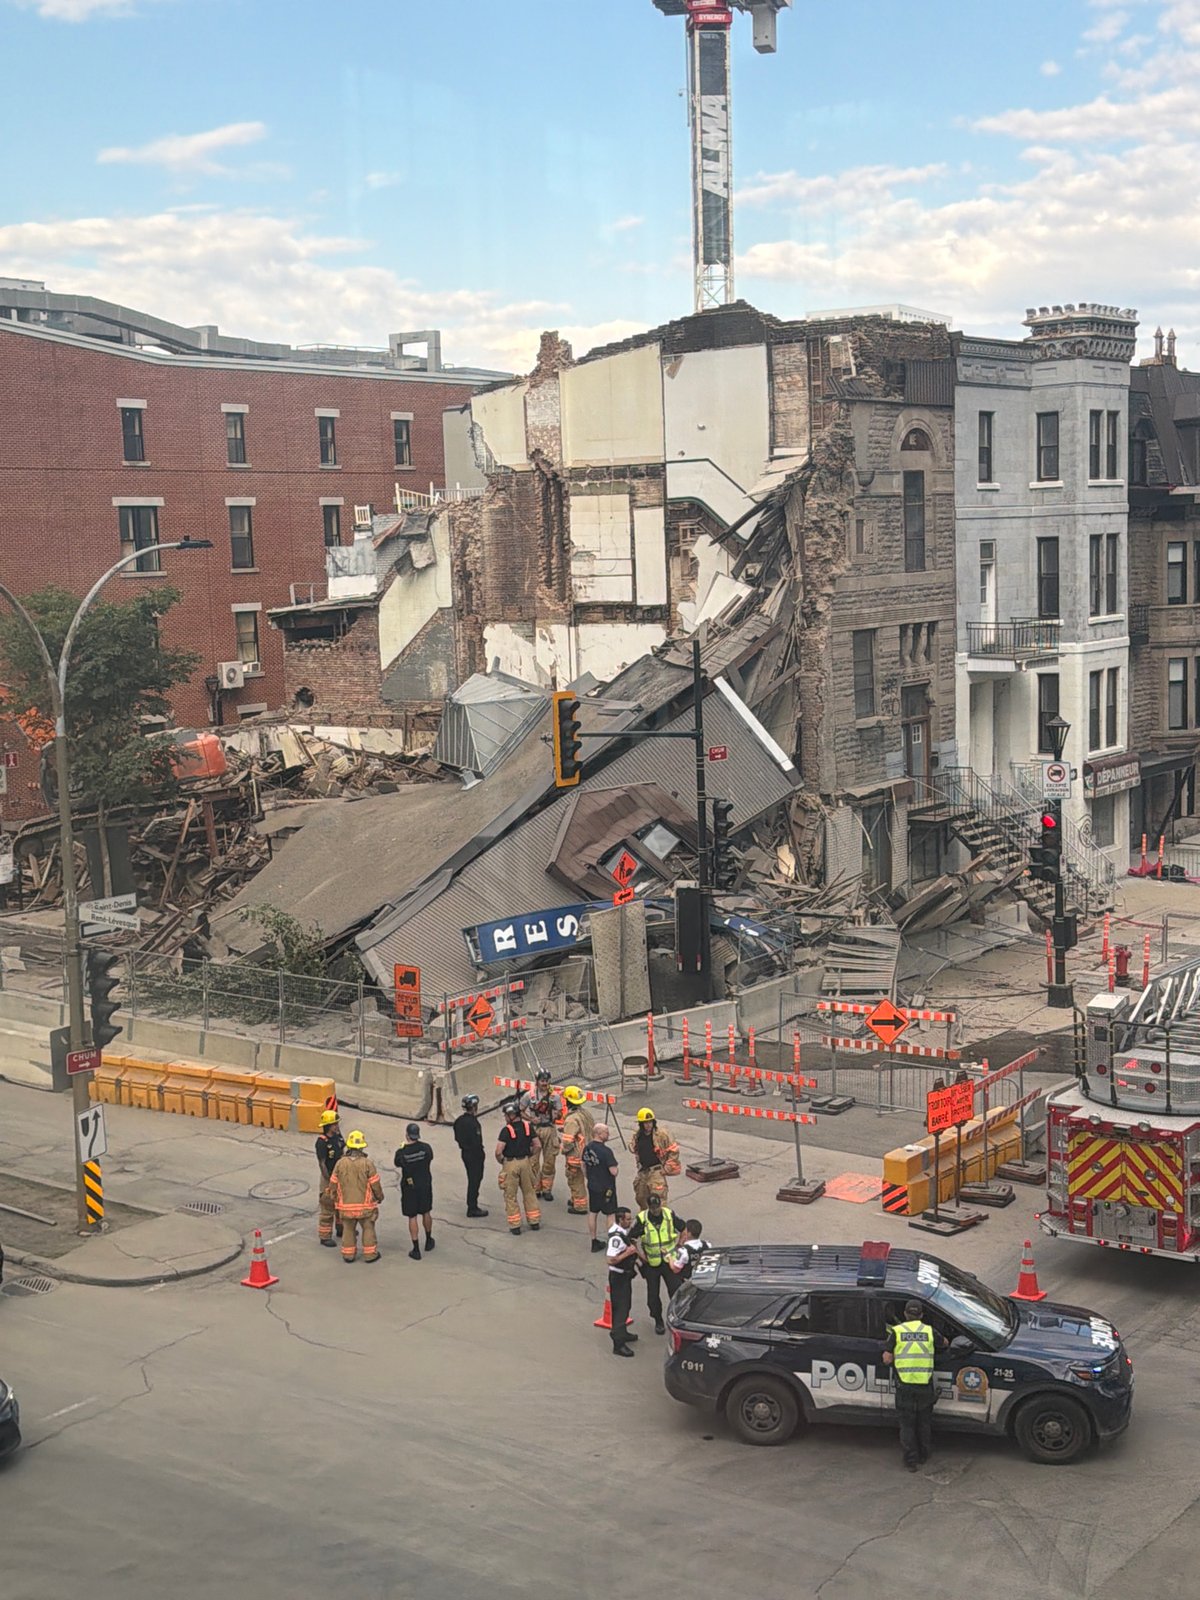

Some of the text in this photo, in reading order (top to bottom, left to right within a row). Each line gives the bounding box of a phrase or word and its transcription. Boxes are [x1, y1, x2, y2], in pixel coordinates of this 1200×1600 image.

[1096, 761, 1139, 786] DÉPANNEUR
[901, 1333, 928, 1341] POLICE
[687, 1361, 704, 1372] 911
[993, 1368, 1014, 1378] 21-25
[811, 1359, 953, 1399] POLE
